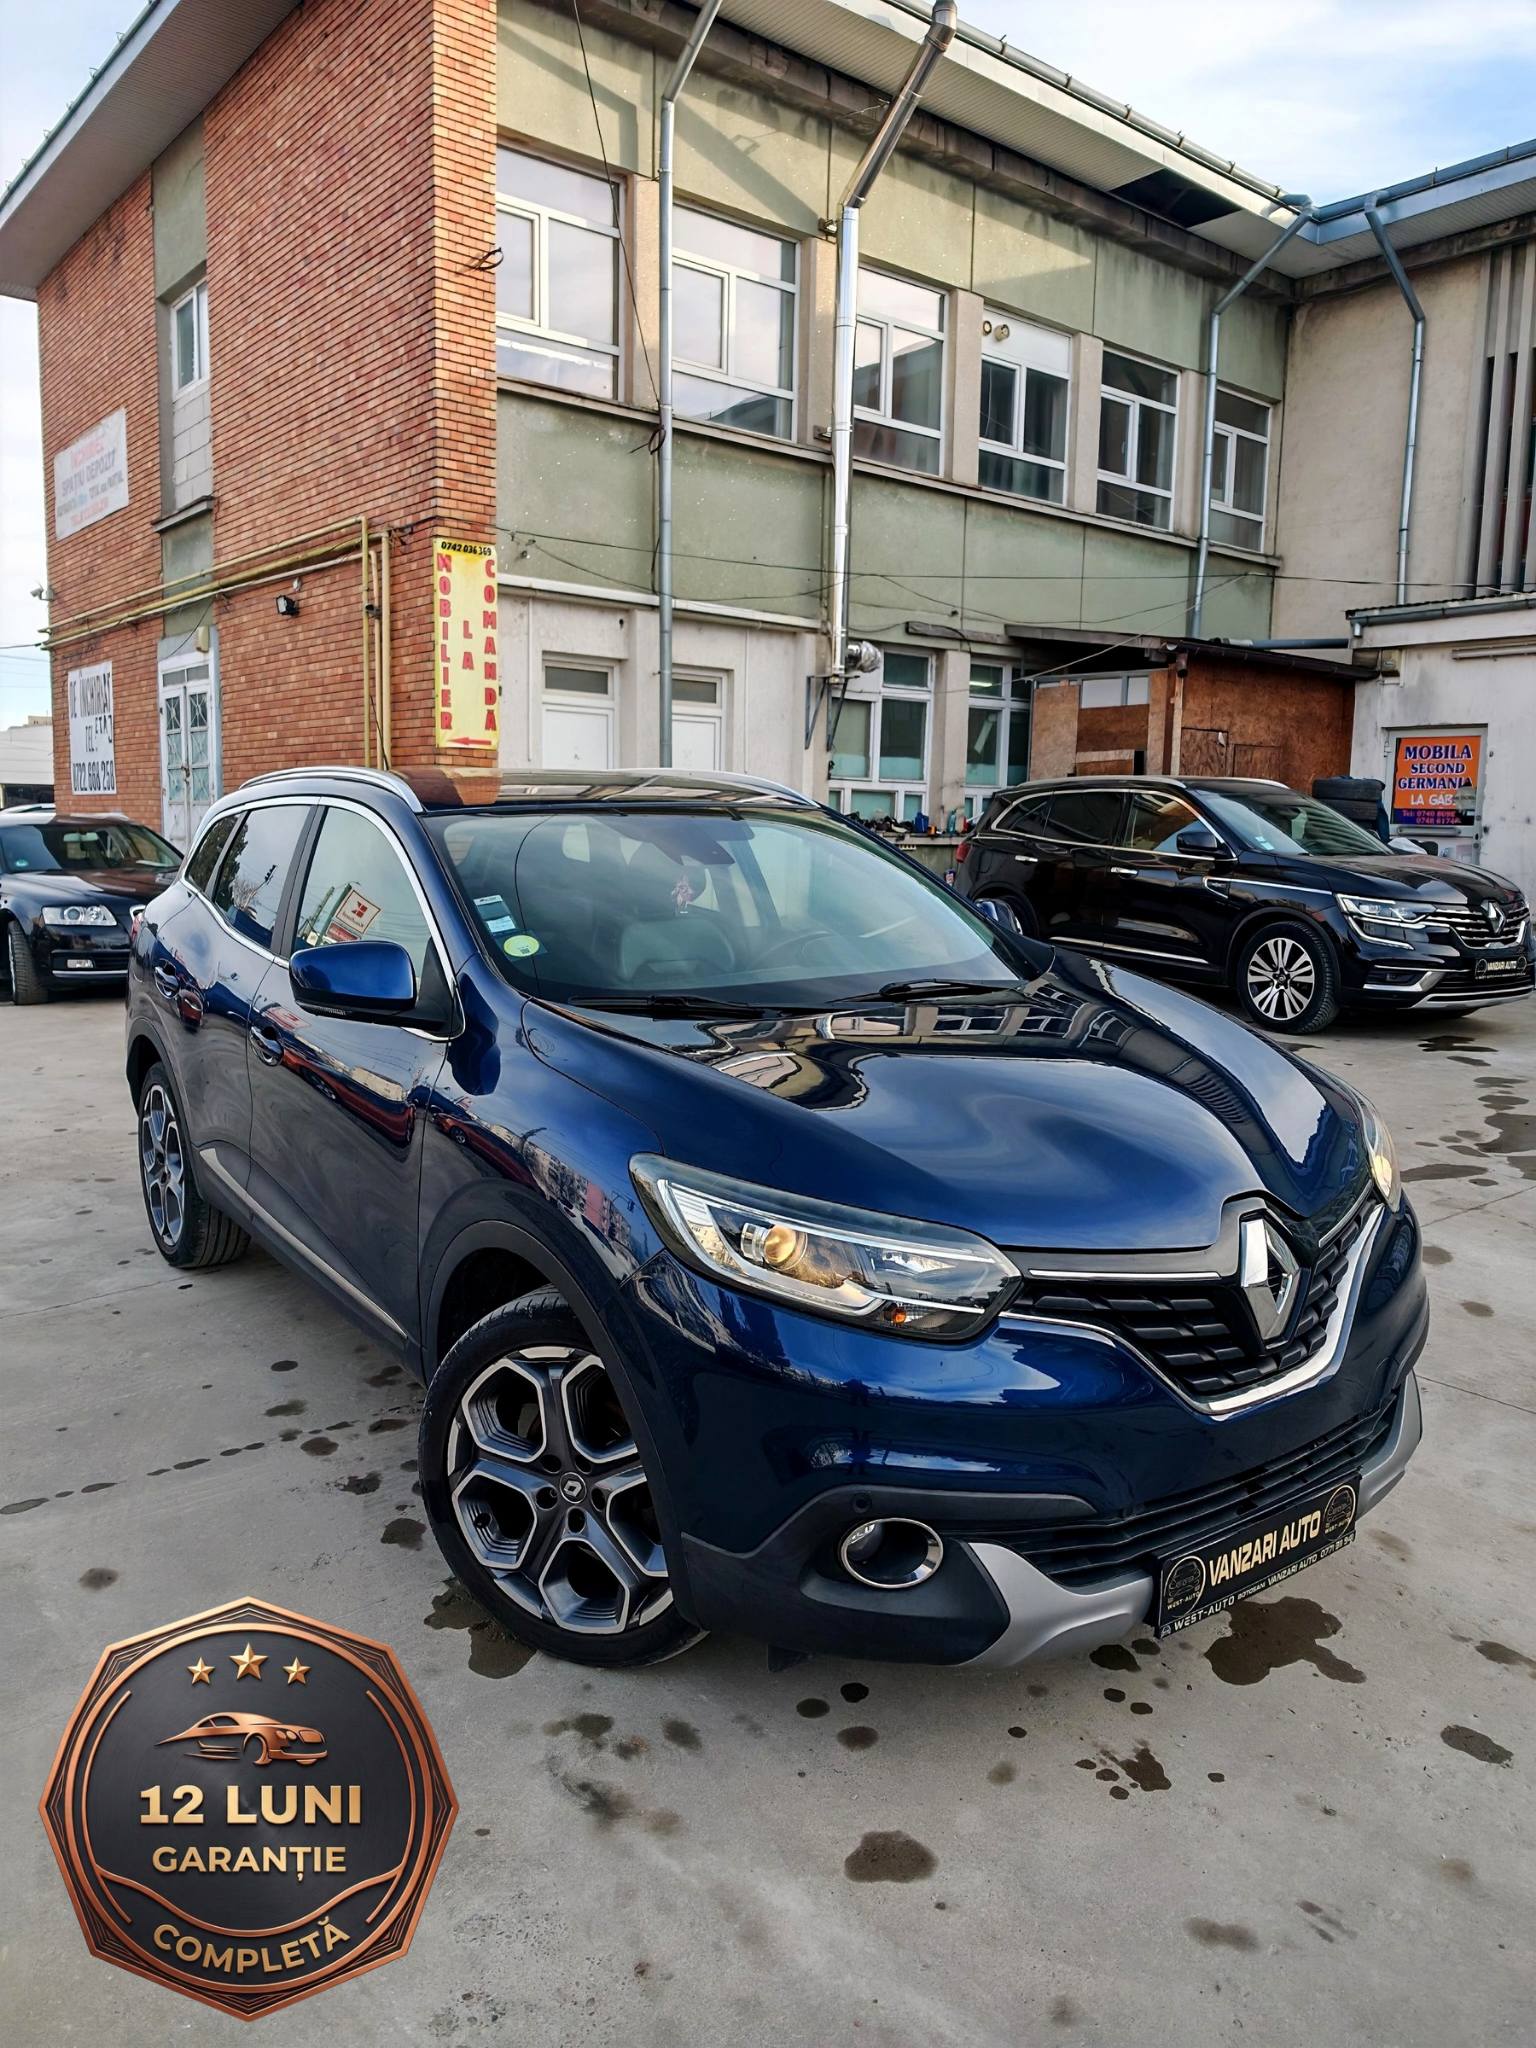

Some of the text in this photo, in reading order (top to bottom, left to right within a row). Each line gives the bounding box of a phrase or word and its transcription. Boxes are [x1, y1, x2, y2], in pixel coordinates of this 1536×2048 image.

[441, 541, 462, 551] 0742
[1404, 744, 1472, 760] MOBILA
[1410, 762, 1466, 775] SECOND
[1410, 794, 1424, 805] LA
[1209, 1510, 1322, 1587] VANZARI AUTO
[1174, 1595, 1235, 1631] WEST-AUTO
[1298, 1554, 1318, 1571] AUTO
